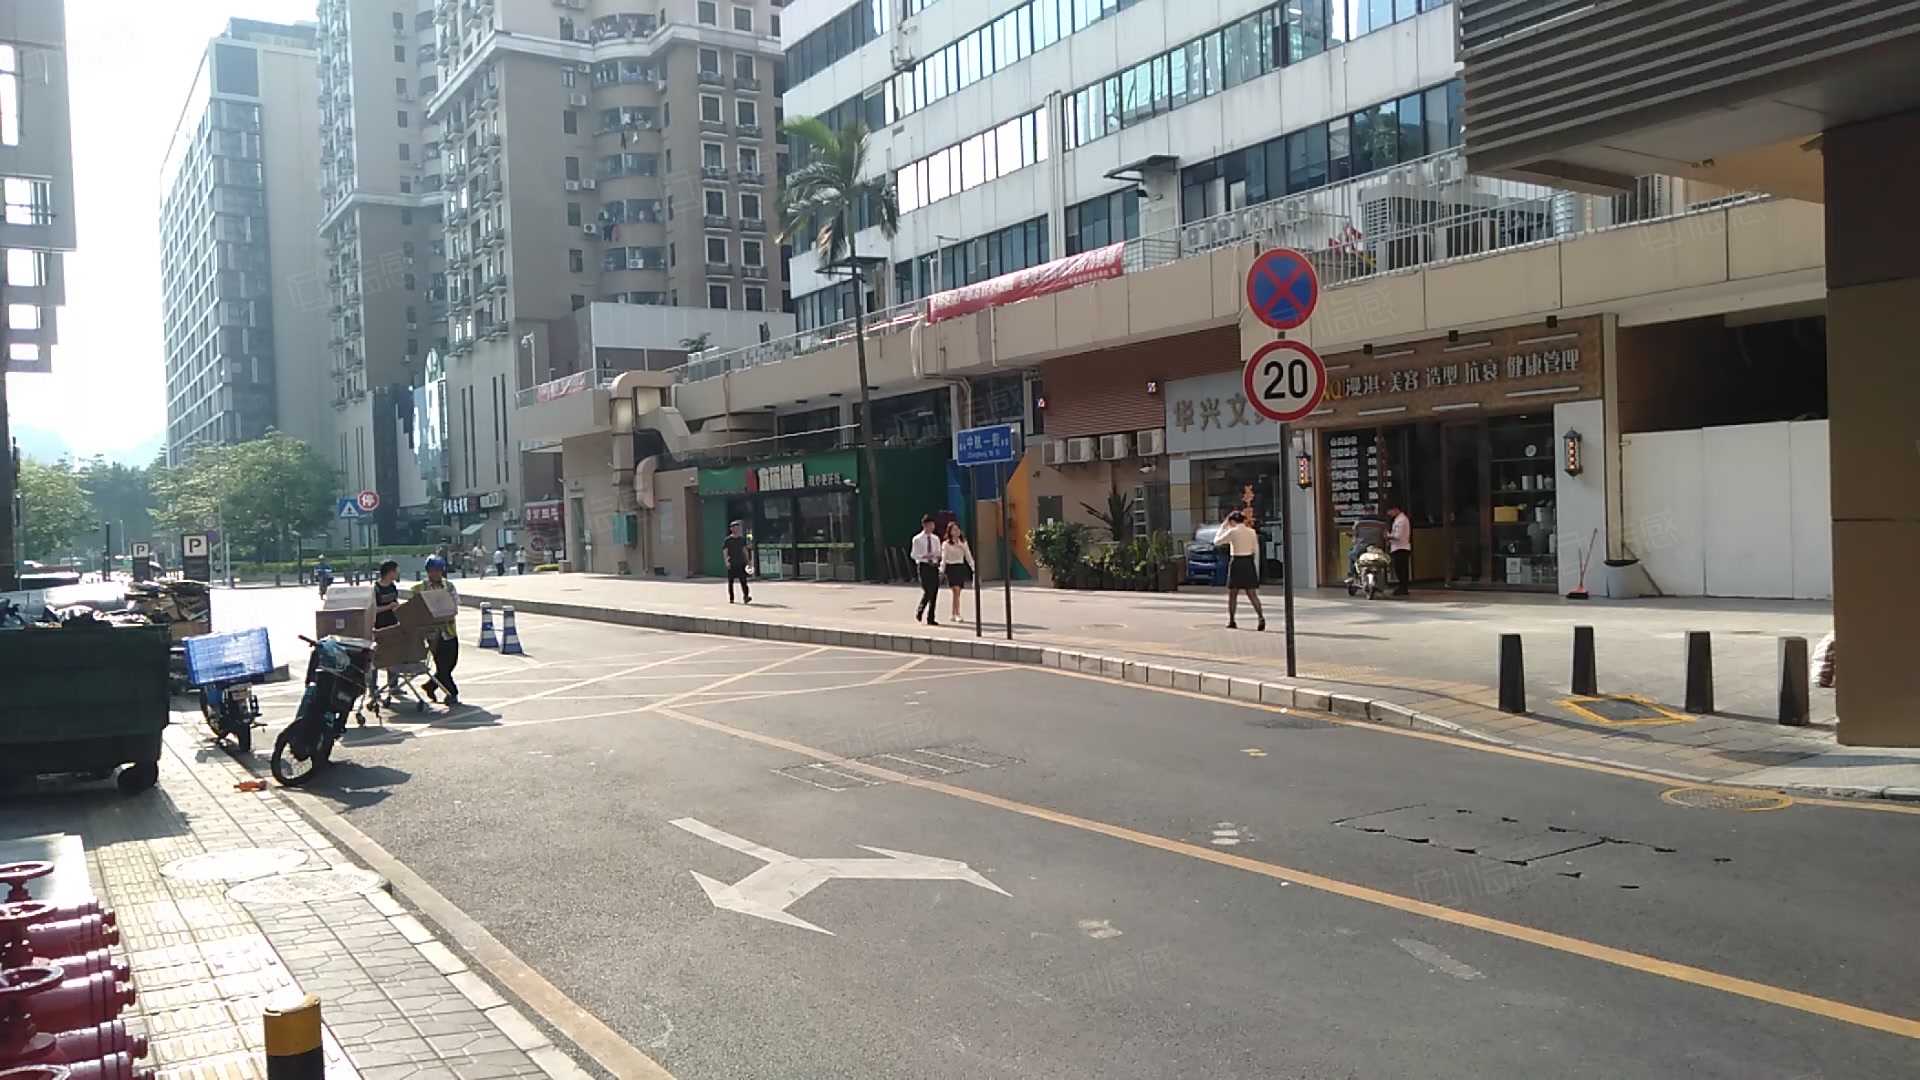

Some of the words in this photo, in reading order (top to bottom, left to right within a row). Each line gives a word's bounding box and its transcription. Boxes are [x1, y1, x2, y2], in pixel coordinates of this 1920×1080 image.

[1264, 359, 1308, 399] 20
[1426, 364, 1457, 388] 造型
[1464, 359, 1499, 384] 抗衰
[1507, 349, 1580, 378] 健康管理
[1173, 392, 1270, 433] 华兴文
[360, 493, 375, 506] 停
[136, 545, 145, 556] P
[189, 538, 202, 554] P
